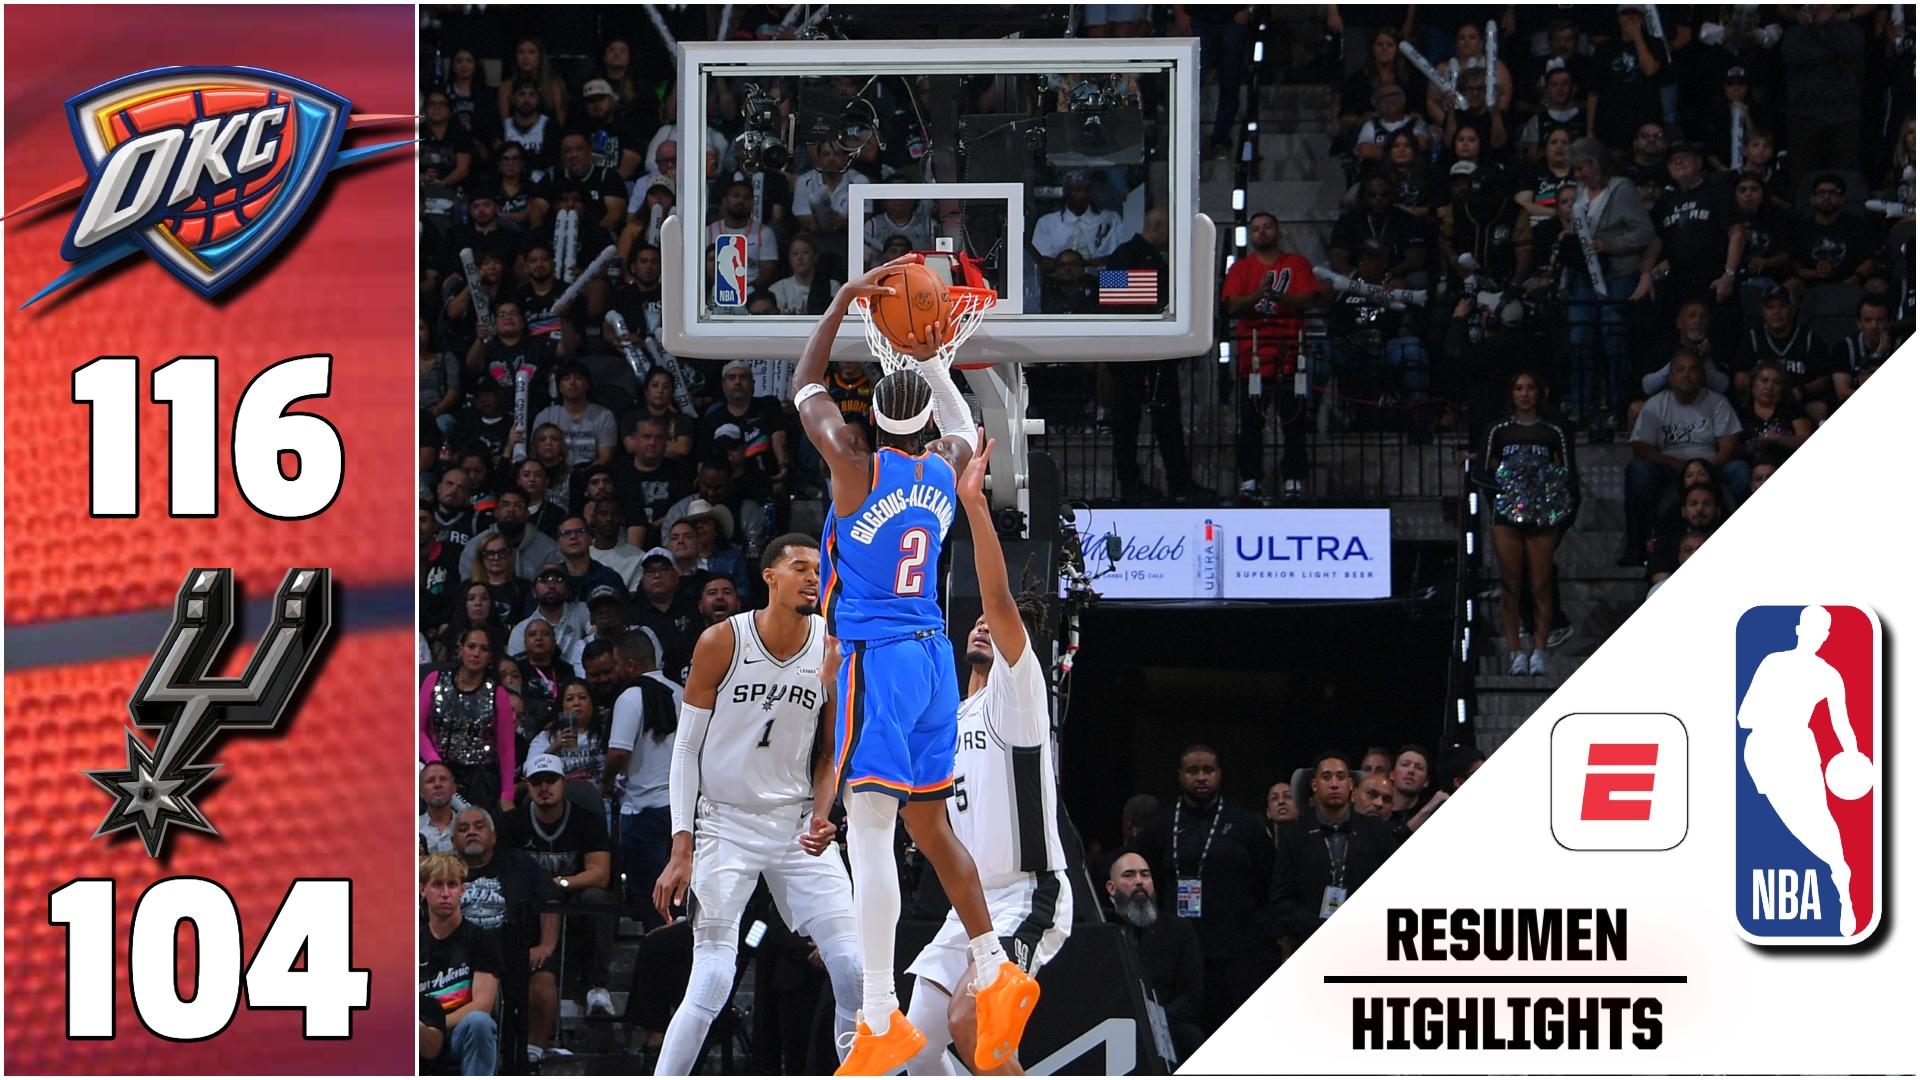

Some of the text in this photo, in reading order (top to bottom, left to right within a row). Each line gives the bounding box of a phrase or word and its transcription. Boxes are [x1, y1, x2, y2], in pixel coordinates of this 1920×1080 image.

[719, 289, 735, 302] NBA
[1077, 531, 1186, 561] Mihelob
[1236, 536, 1369, 561] ULTRA
[895, 526, 929, 597] 2
[1131, 570, 1145, 580] 95
[1204, 545, 1214, 590] ULTRA
[732, 684, 817, 711] SPURS
[757, 718, 775, 748] 1
[953, 775, 968, 813] 5
[431, 962, 470, 989] Antonio
